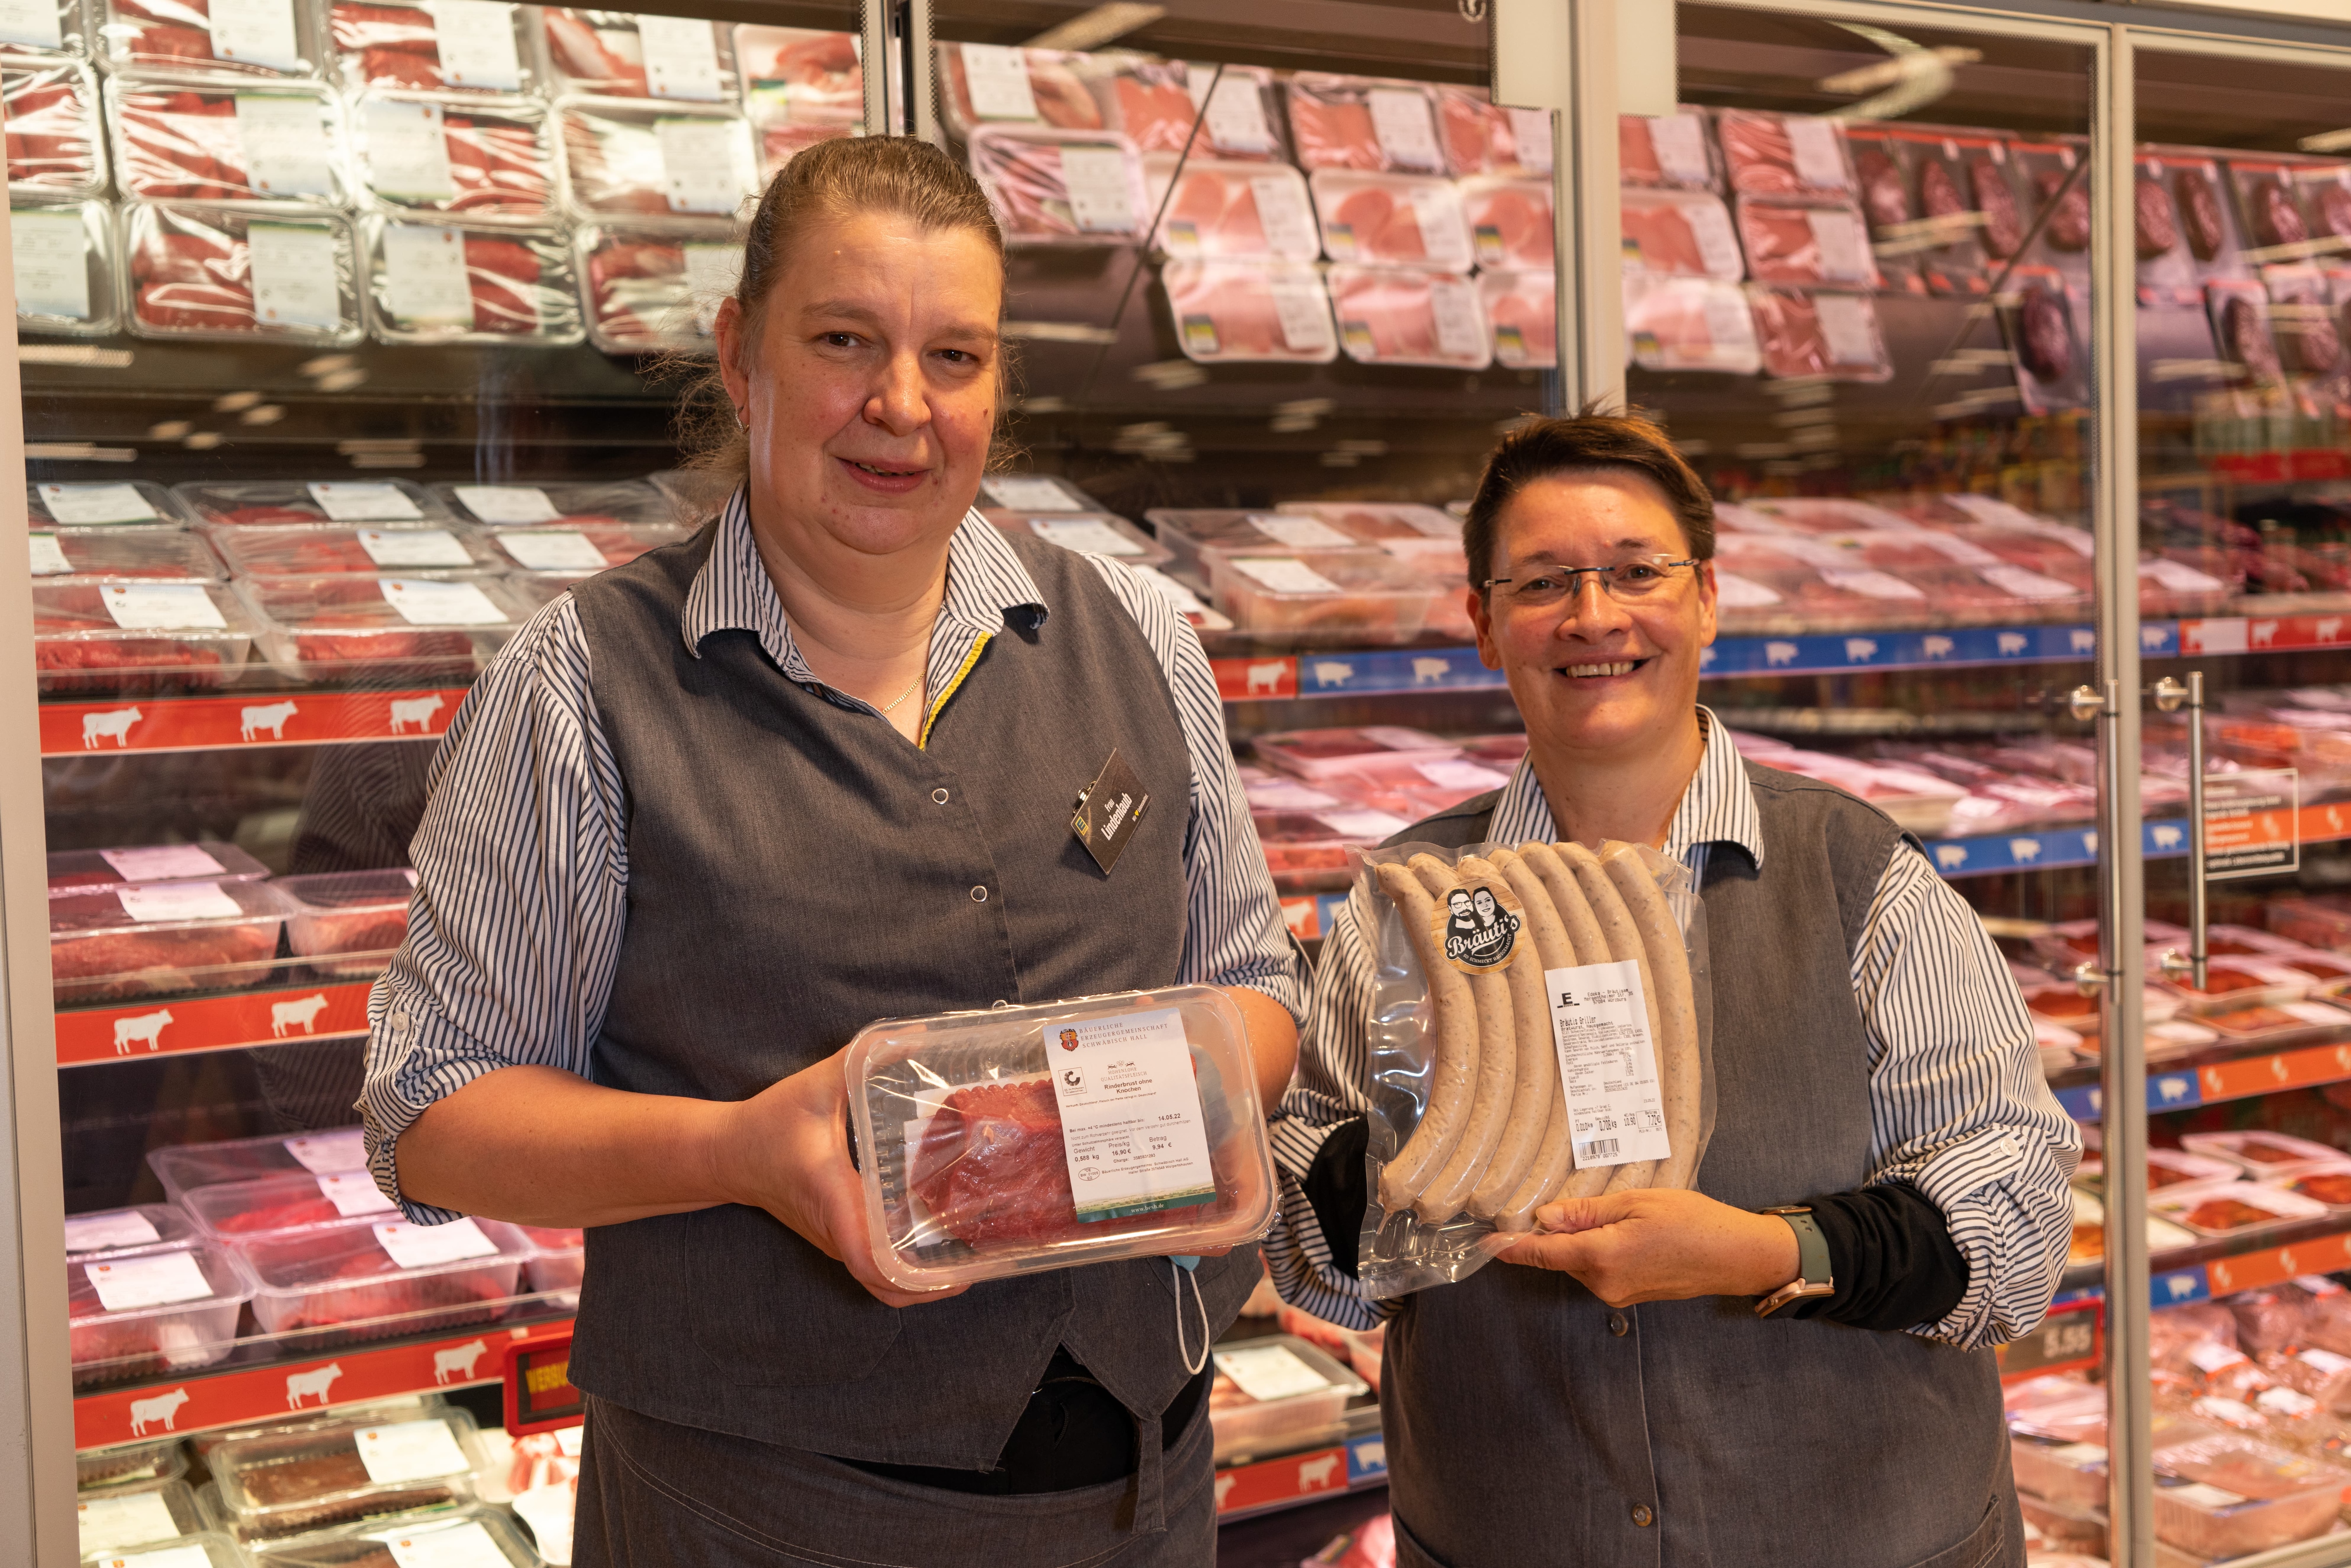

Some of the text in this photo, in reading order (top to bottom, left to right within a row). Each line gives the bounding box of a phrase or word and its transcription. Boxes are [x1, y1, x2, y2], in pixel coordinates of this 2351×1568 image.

[1104, 798, 1114, 812] Frau
[1101, 793, 1132, 841] Lindenlaub
[1077, 819, 1086, 831] E
[1493, 933, 1512, 961] HAUSGEMACHT
[1562, 992, 1572, 1004] E
[1559, 1015, 1596, 1026] Bräutis Griller
[1079, 1022, 1123, 1033] BÄUERLICHE
[1081, 1023, 1168, 1040] ERZEUGERGEMEINSCHAFT
[1082, 1037, 1127, 1048] SCHWÄBISCH
[1100, 1071, 1147, 1081] QUALITÄTSFLEISCH
[1104, 1080, 1137, 1089] Rinderbrust
[1624, 1117, 1636, 1126] 10.90
[1108, 1140, 1130, 1149] Preis/kg
[1149, 1135, 1167, 1143] Betrag
[1121, 1163, 1152, 1171] Erzeugergemeinsc
[1130, 1203, 1164, 1212] www.besh.de
